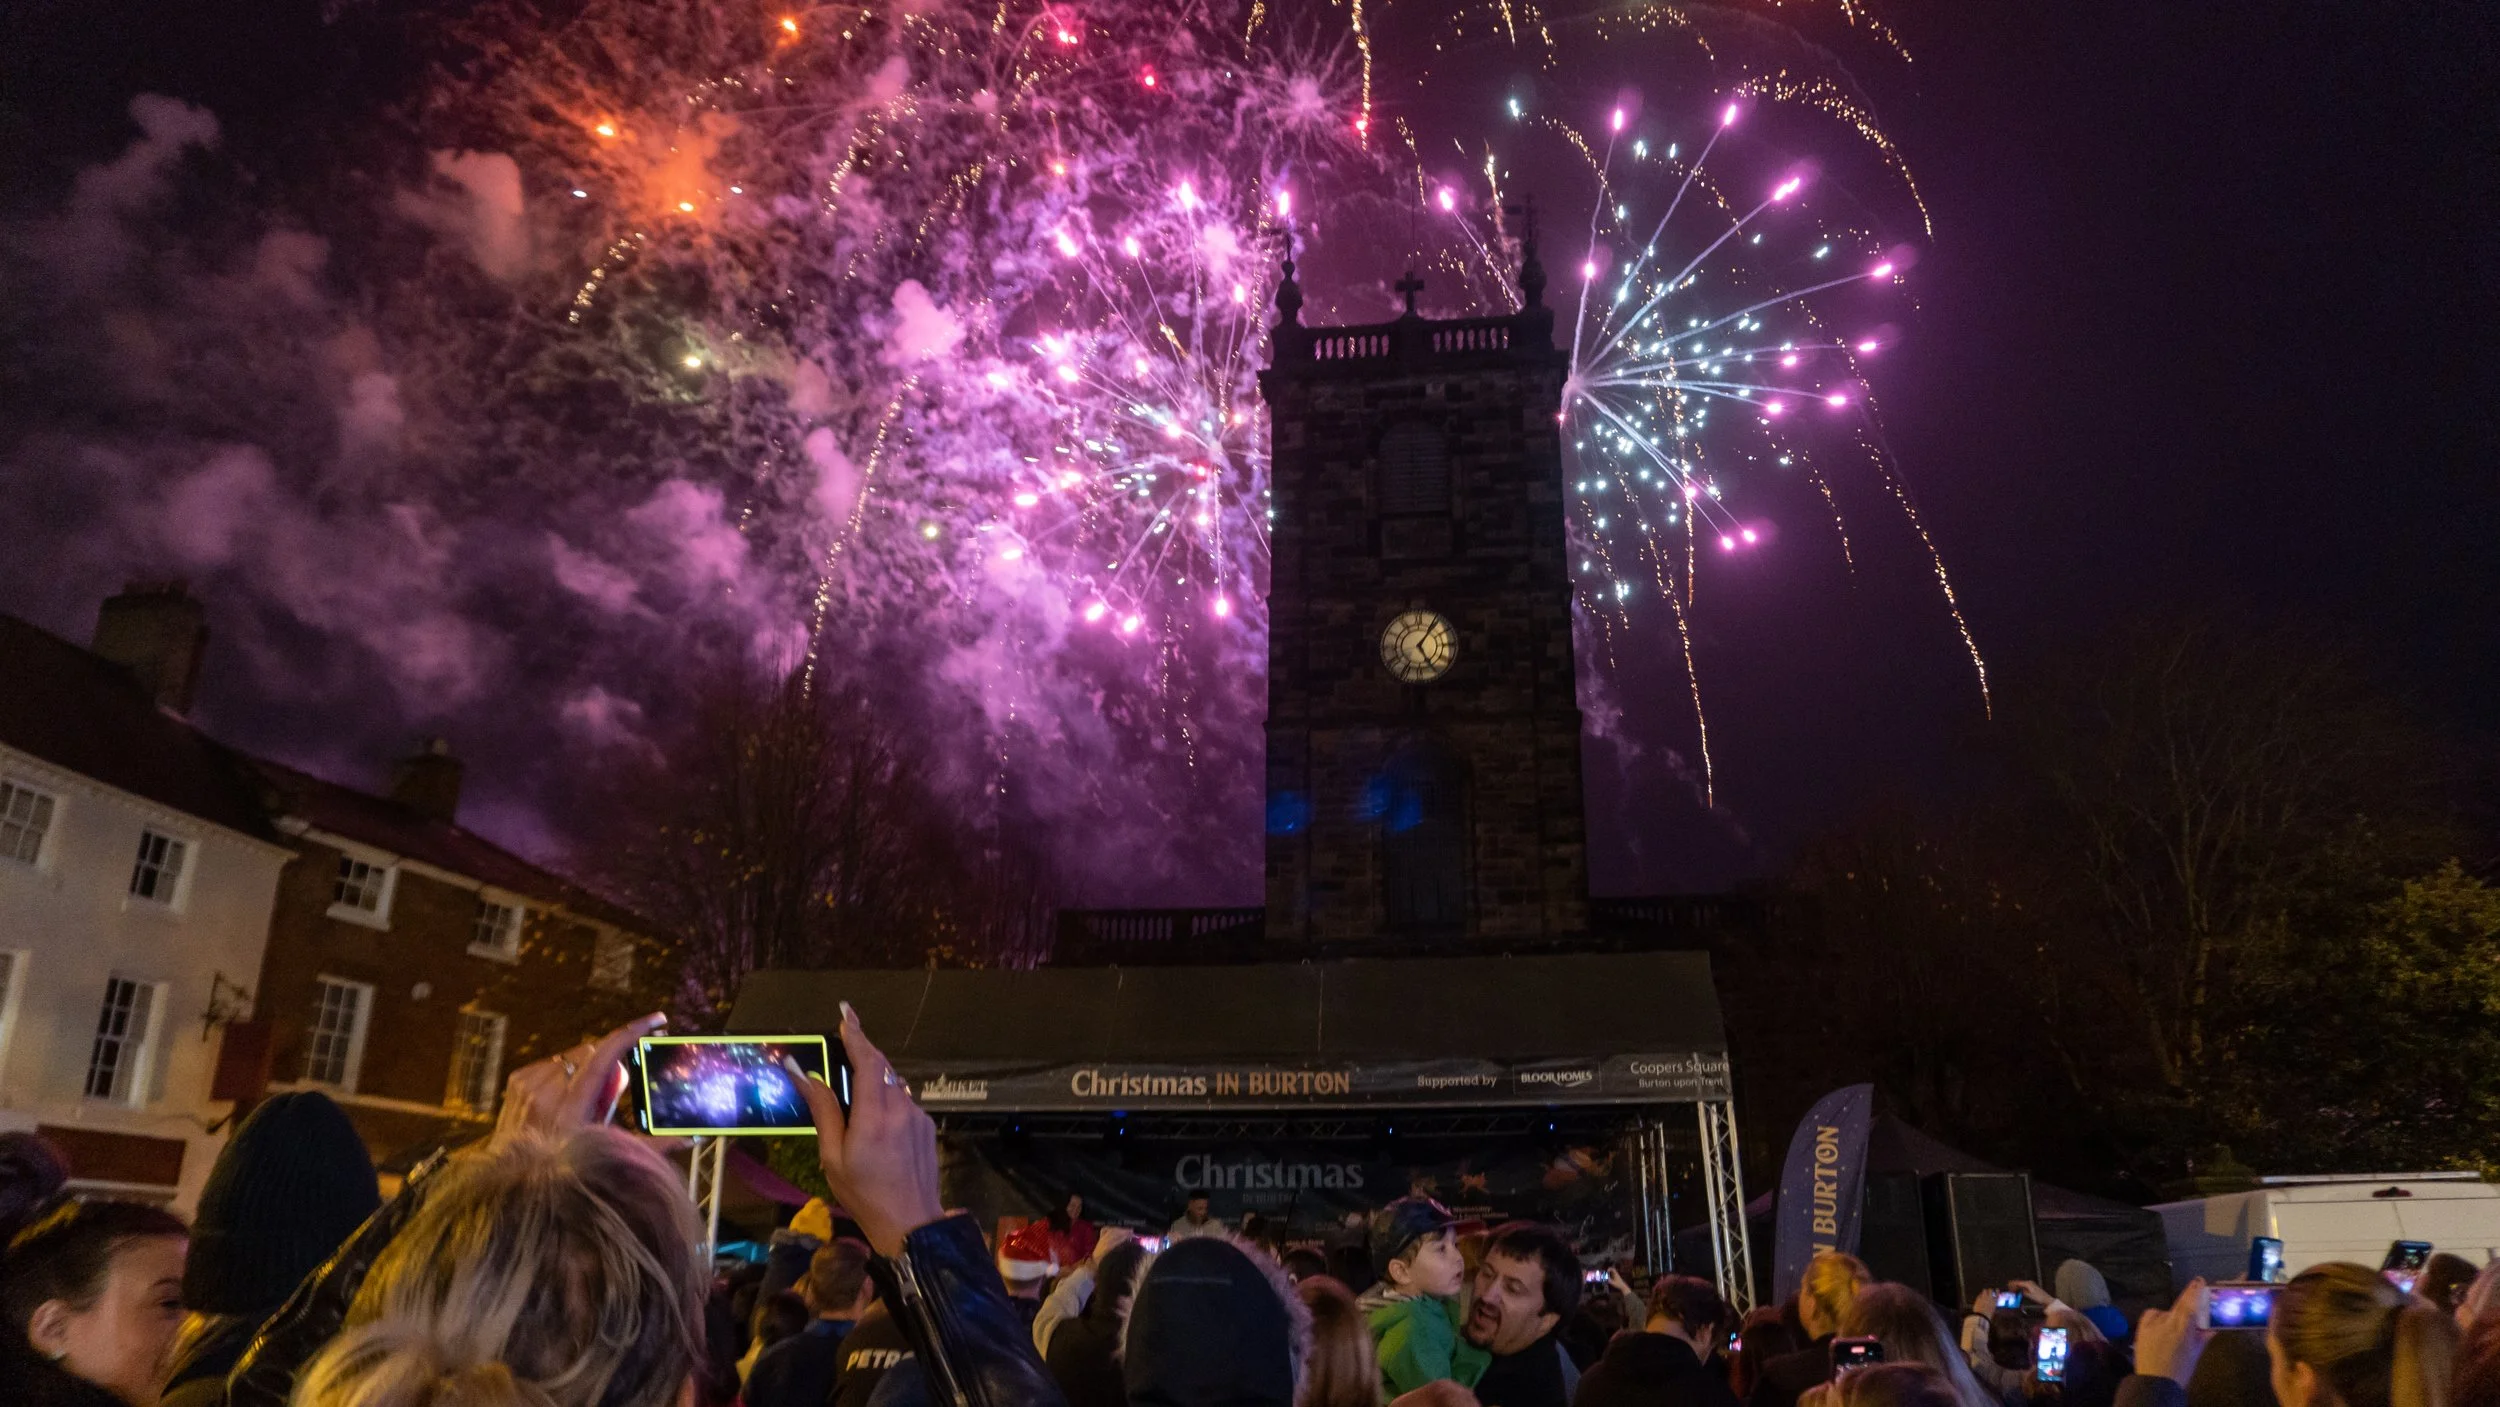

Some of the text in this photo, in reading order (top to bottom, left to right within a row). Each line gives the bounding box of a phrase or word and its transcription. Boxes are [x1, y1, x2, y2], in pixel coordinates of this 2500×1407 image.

[1630, 1059, 1729, 1076] Coopers Square
[1071, 1069, 1351, 1097] Christmas IN BURTON
[1417, 1074, 1497, 1090] Supported by
[1556, 1070, 1593, 1083] HOMES
[1639, 1076, 1723, 1090] Burton upon Trent
[1175, 1152, 1365, 1190] Christmas
[1812, 1125, 1840, 1236] BURTON
